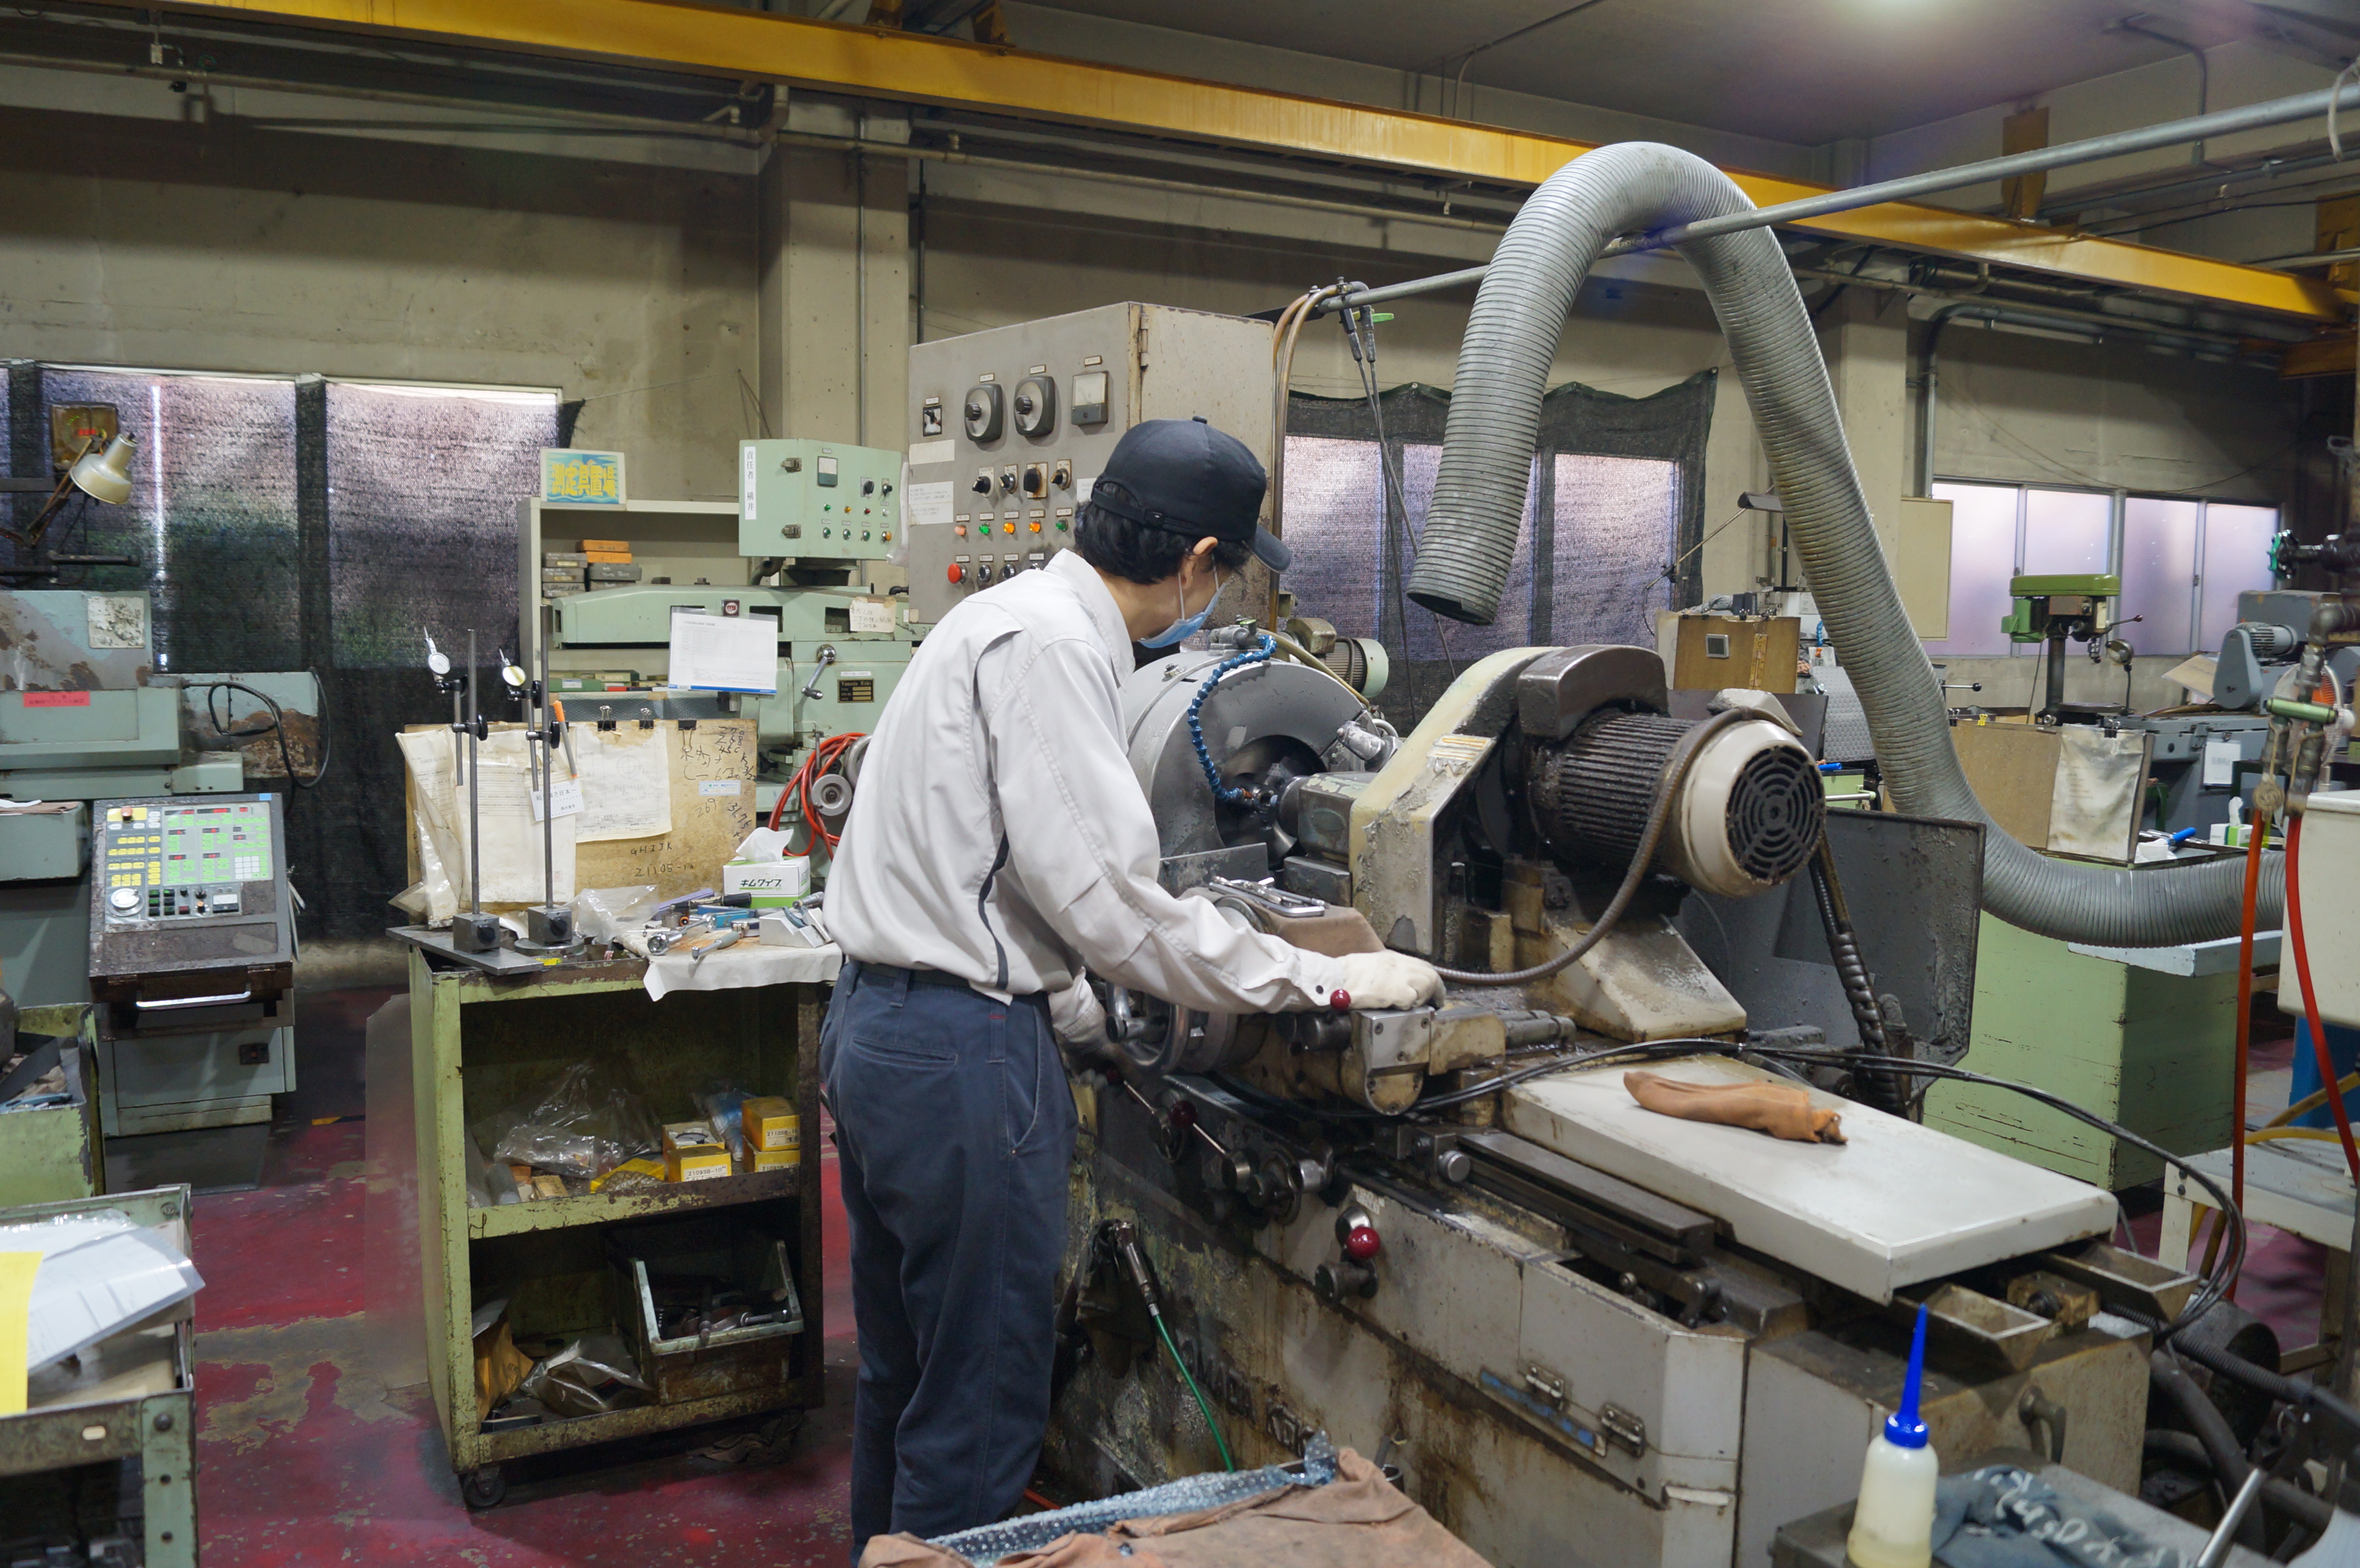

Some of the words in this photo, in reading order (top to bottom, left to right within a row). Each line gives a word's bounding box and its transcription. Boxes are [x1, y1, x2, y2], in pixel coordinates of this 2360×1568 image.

[551, 463, 616, 497] 測定具置場
[747, 491, 754, 511] 横井
